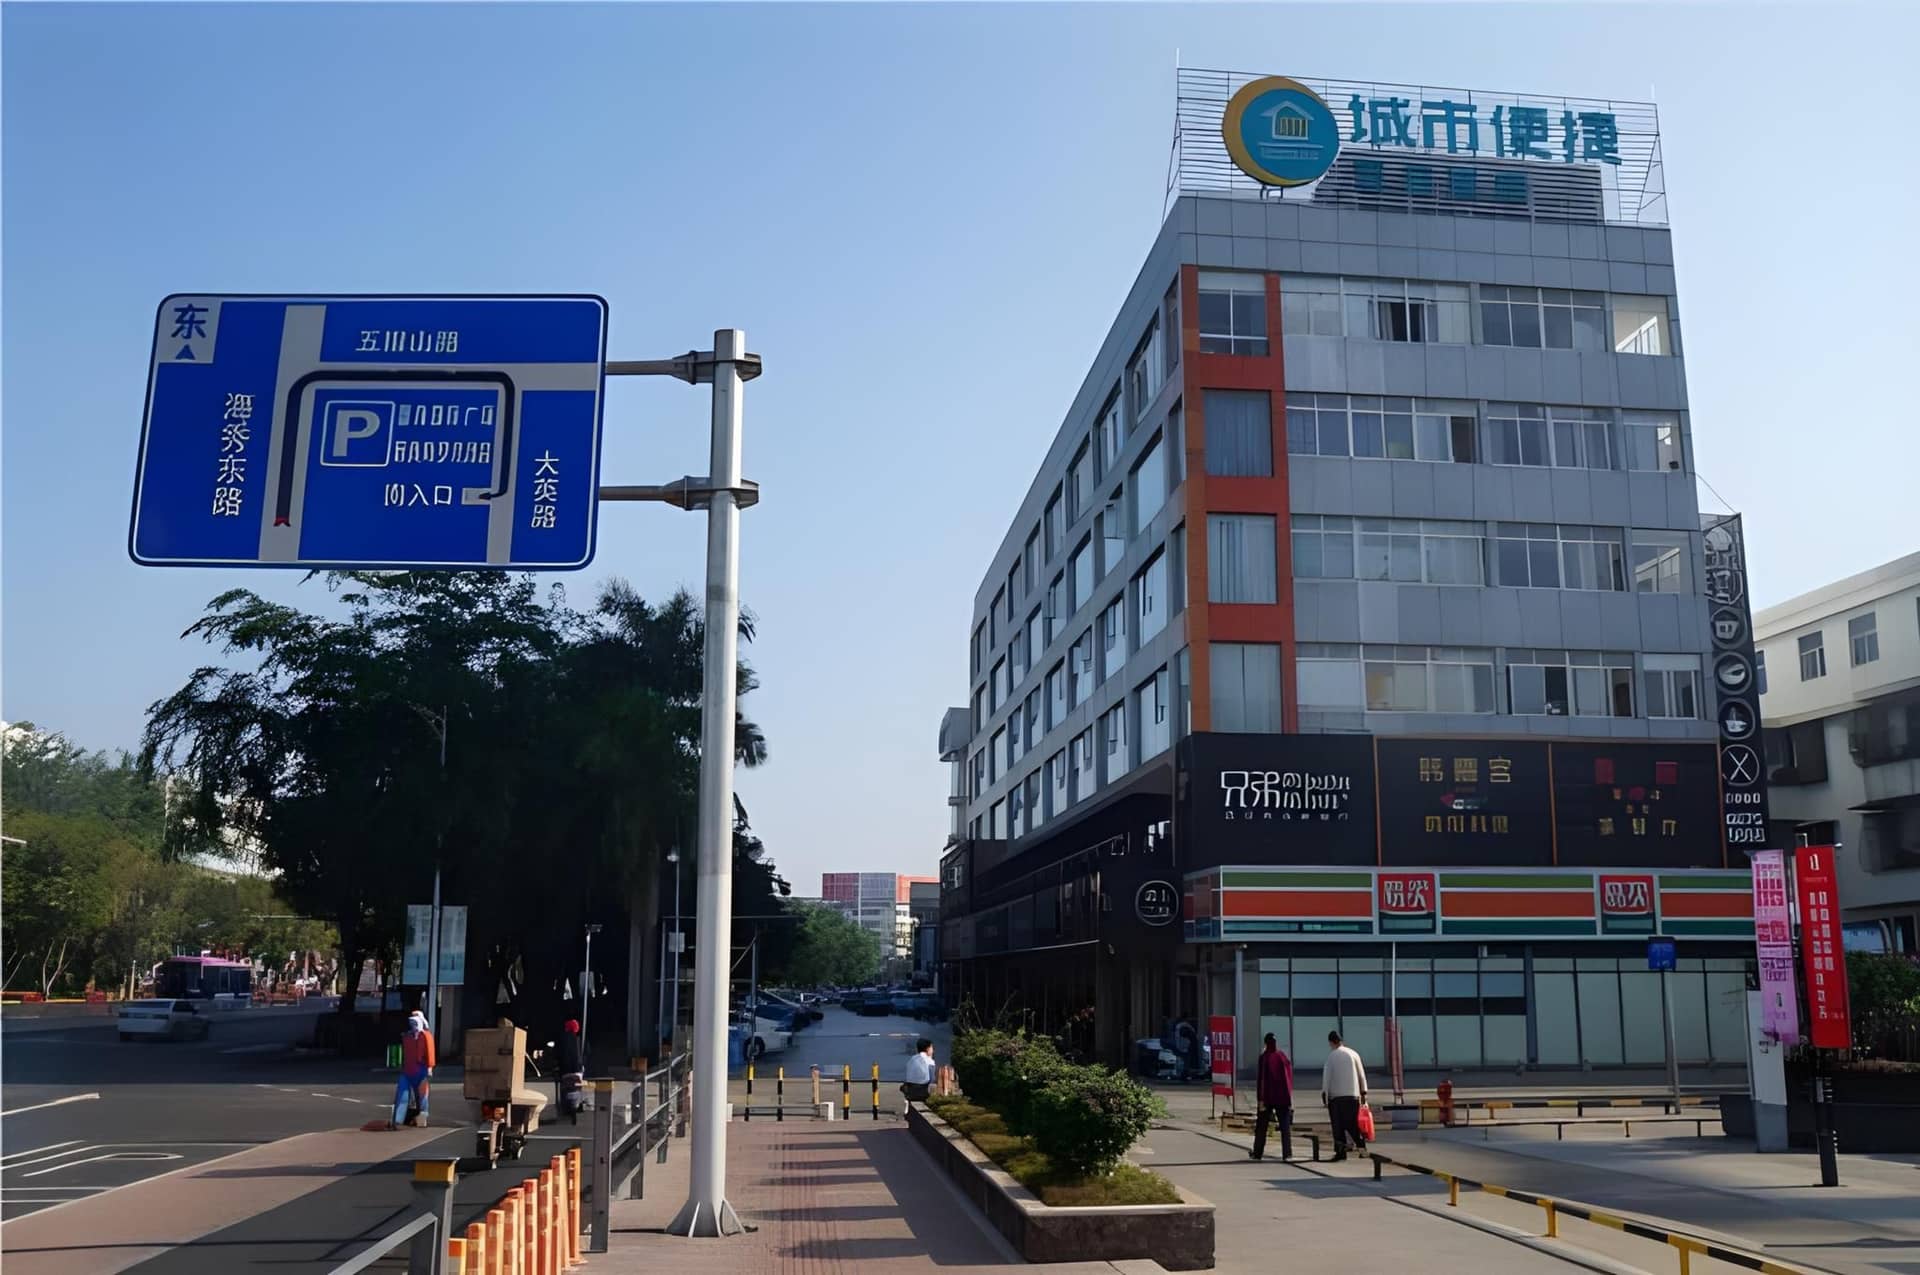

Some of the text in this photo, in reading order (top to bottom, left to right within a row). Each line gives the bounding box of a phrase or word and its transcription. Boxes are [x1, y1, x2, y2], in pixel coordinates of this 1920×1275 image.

[1348, 94, 1622, 165] 城市便捷
[170, 304, 209, 340] 东
[355, 330, 458, 353] 五山路
[332, 409, 380, 457] P
